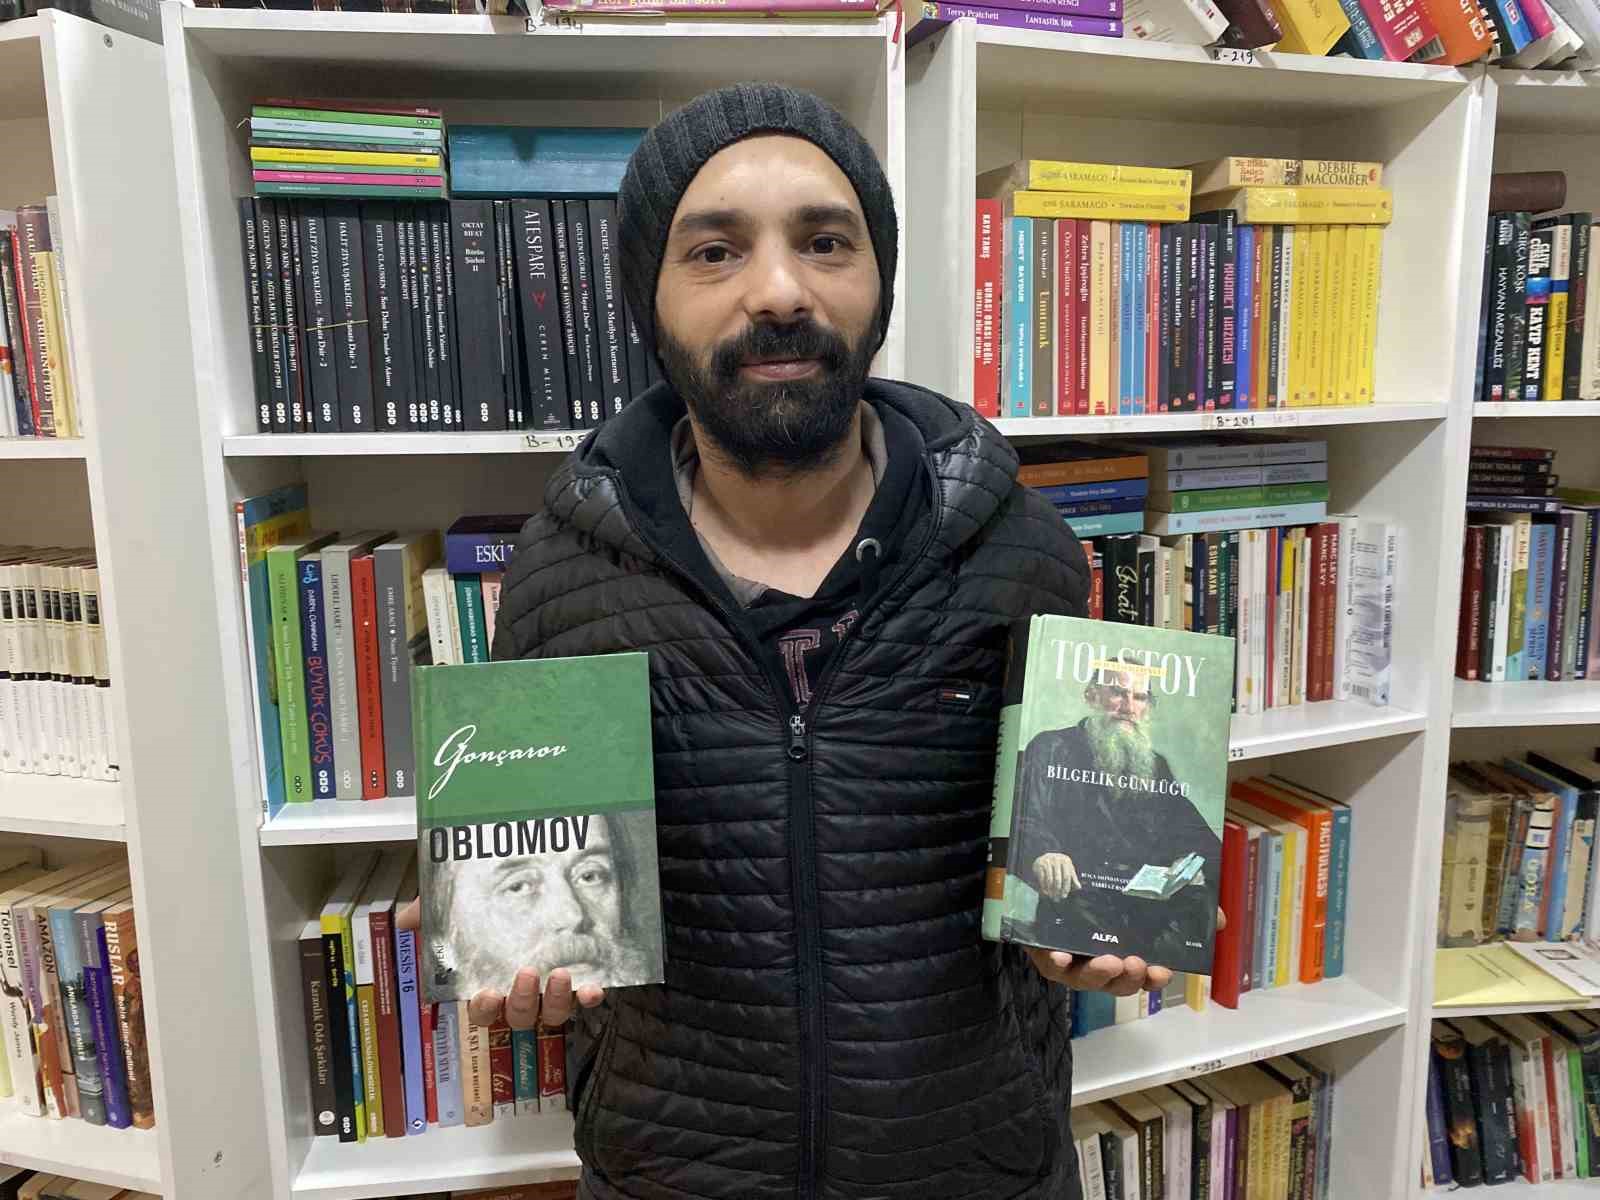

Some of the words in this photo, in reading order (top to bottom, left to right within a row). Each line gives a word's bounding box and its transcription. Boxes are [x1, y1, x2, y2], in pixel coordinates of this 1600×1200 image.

[946, 7, 966, 19] Terry
[1304, 173, 1369, 186] MACOMBER
[1317, 161, 1358, 173] DEBBIE
[599, 219, 610, 252] MICHEL
[1499, 220, 1511, 246] KING
[248, 252, 256, 269] AKIN
[265, 251, 273, 269] AKIN
[281, 251, 289, 269] AKIN
[602, 253, 614, 301] SCHNEIDER
[1495, 267, 1508, 311] HAYVAN
[1039, 290, 1051, 349] Unutmak
[1528, 306, 1543, 345] KAYIP
[610, 345, 622, 384] Kurtarmak
[1526, 347, 1541, 380] KENT
[474, 540, 505, 562] ESKİ
[1320, 534, 1328, 561] MARC
[1330, 533, 1338, 560] MARC
[1319, 562, 1327, 587] LEVY
[1329, 561, 1337, 585] LEVY
[307, 655, 324, 705] BÜYÜK
[1048, 638, 1206, 698] TOLSTOY
[427, 723, 568, 801] Gonçarov
[1045, 764, 1114, 790] BİLGELİK
[1117, 772, 1191, 799] GÜNLÜĞÜ
[428, 815, 590, 863] OBLOMOV
[1317, 820, 1333, 898] FACTFULNESS
[38, 914, 55, 974] AMAZON
[104, 921, 126, 986] RUSLAR
[1091, 931, 1119, 944] ALFA
[310, 980, 324, 1021] Karanlık
[401, 980, 415, 993] 16
[314, 1022, 327, 1043] Oda
